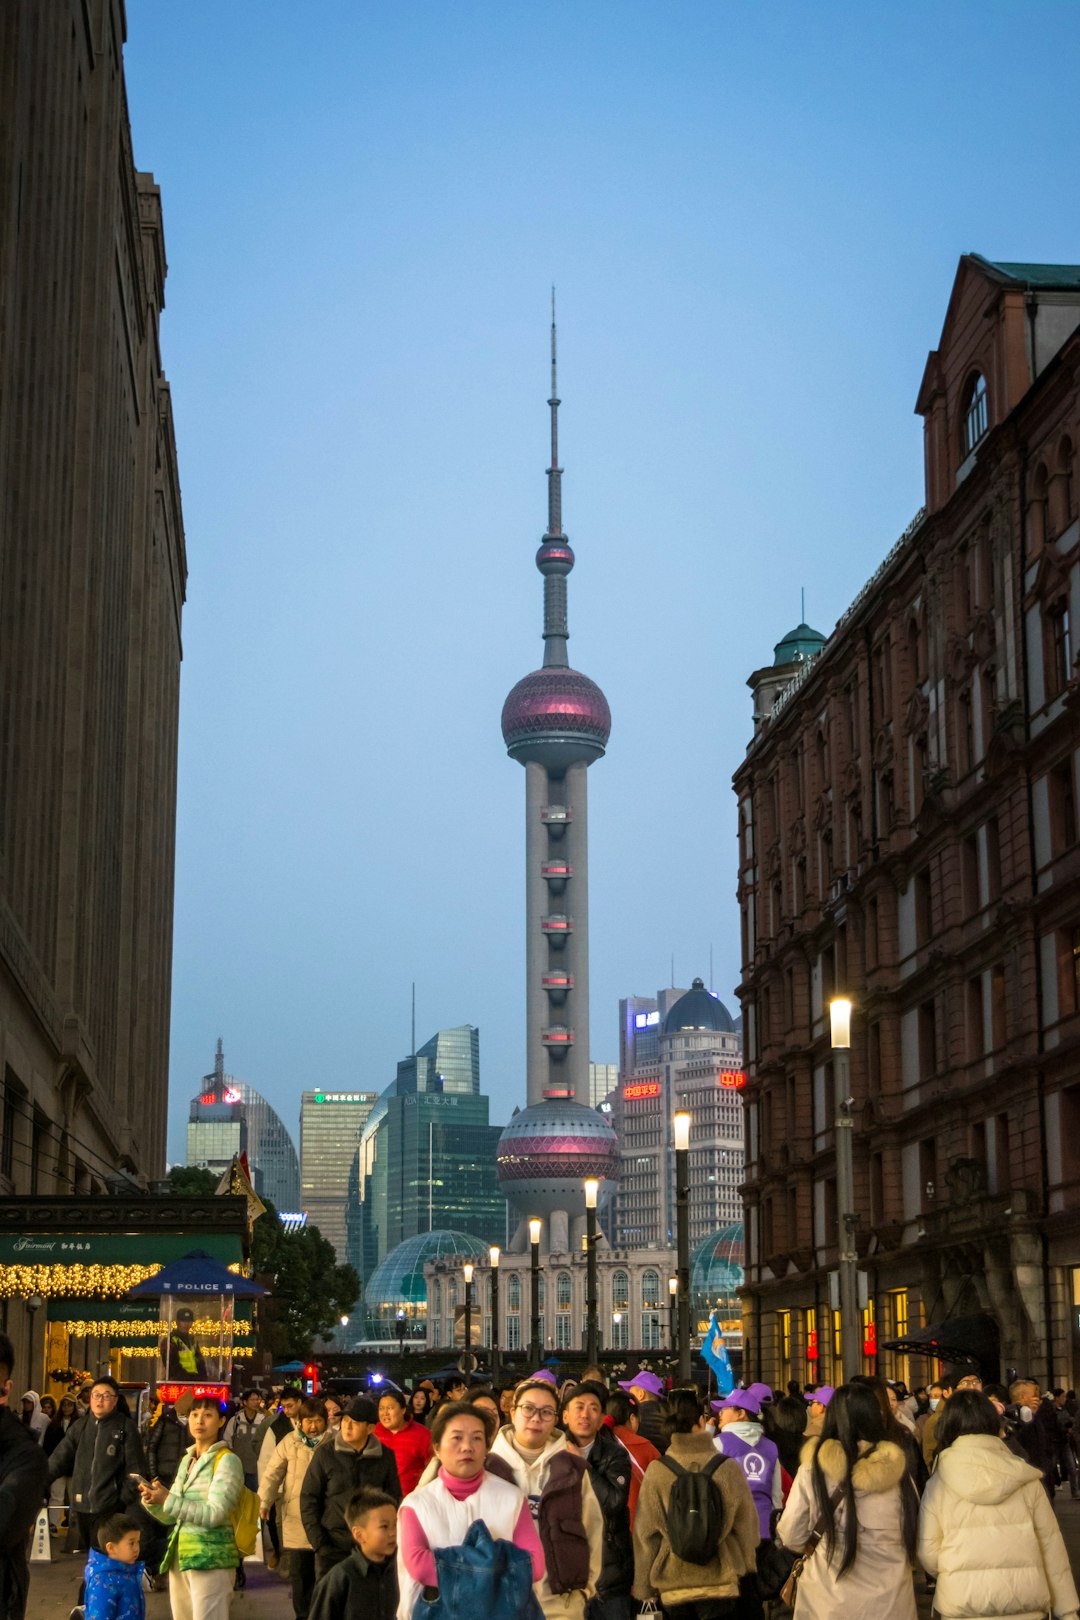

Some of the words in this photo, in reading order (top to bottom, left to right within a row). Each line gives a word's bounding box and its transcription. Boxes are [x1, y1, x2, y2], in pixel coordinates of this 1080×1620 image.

[624, 1084, 657, 1097] 中国平安
[424, 1095, 458, 1106] 汇亚大厦
[13, 1236, 56, 1251] Fairmont
